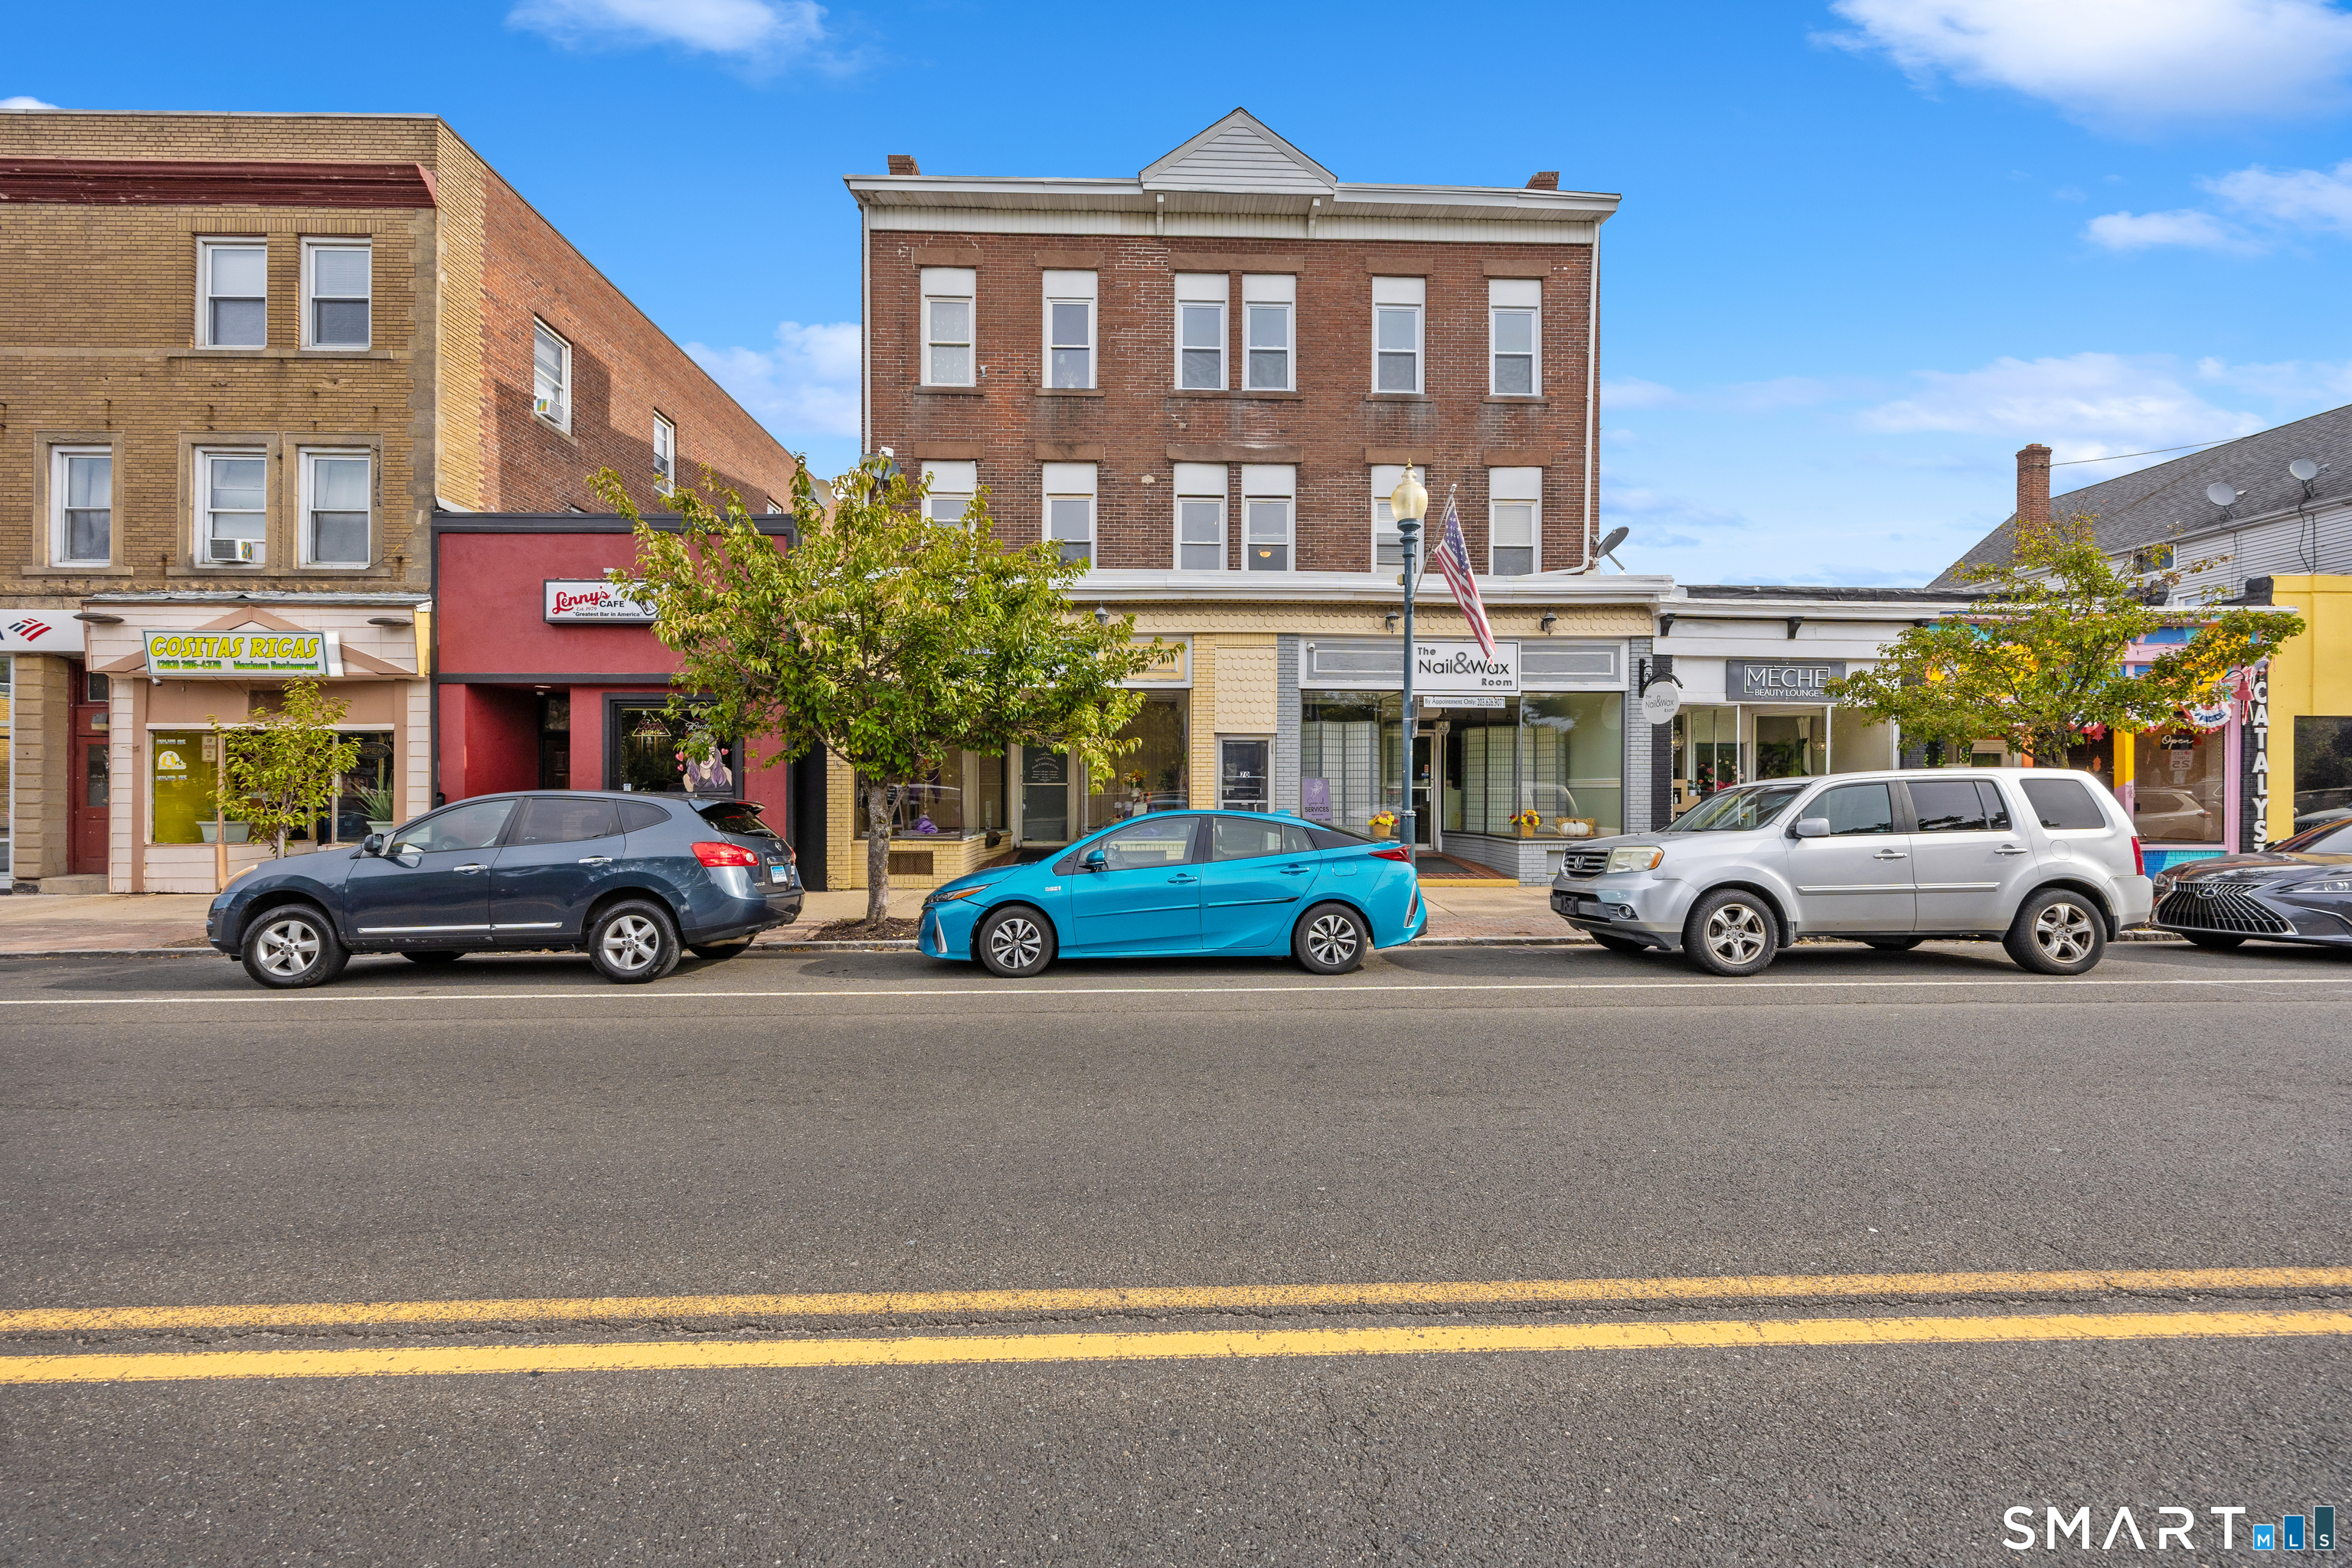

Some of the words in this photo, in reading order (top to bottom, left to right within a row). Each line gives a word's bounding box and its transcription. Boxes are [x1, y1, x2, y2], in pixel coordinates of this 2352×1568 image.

[552, 586, 611, 614] Lenny's
[150, 636, 244, 658] COSITAS
[250, 638, 320, 659] RICAS
[1417, 647, 1436, 655] The
[157, 660, 180, 670] (203)
[234, 661, 269, 671] Mexican
[271, 661, 319, 671] Restaurant
[1419, 652, 1510, 675] Nail&Wax
[1785, 689, 1819, 697] LOUNGE
[1477, 698, 1505, 707] 203.626.9071
[1645, 695, 1674, 709] Nail&Wax
[637, 719, 665, 730] Coors
[2161, 734, 2194, 750] Open
